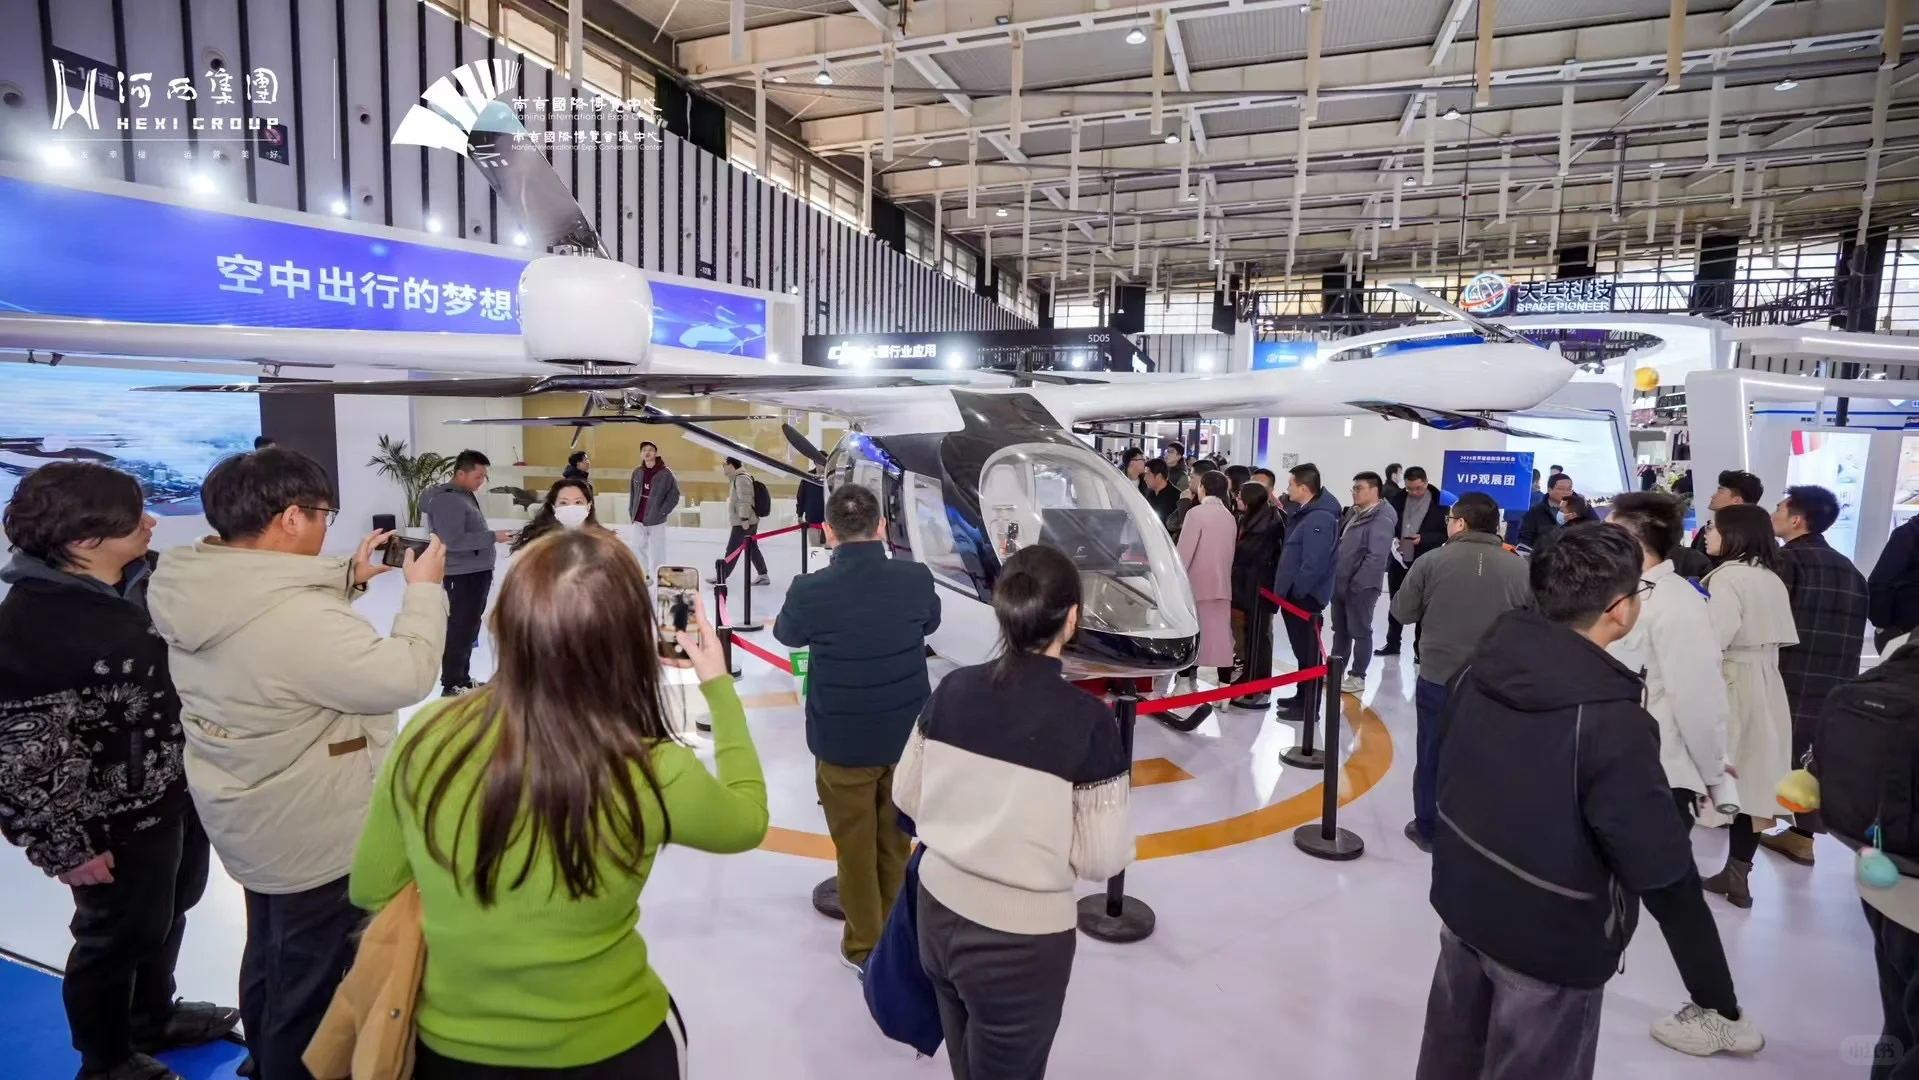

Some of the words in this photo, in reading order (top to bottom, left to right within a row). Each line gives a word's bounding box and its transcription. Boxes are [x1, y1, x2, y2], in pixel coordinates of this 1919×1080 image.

[216, 253, 521, 321] 空中出行的梦想
[1518, 279, 1613, 301] 天兵科技
[1516, 302, 1556, 312] SPACE
[1557, 301, 1610, 311] PIONEER
[1457, 473, 1516, 486] VIP观展团
